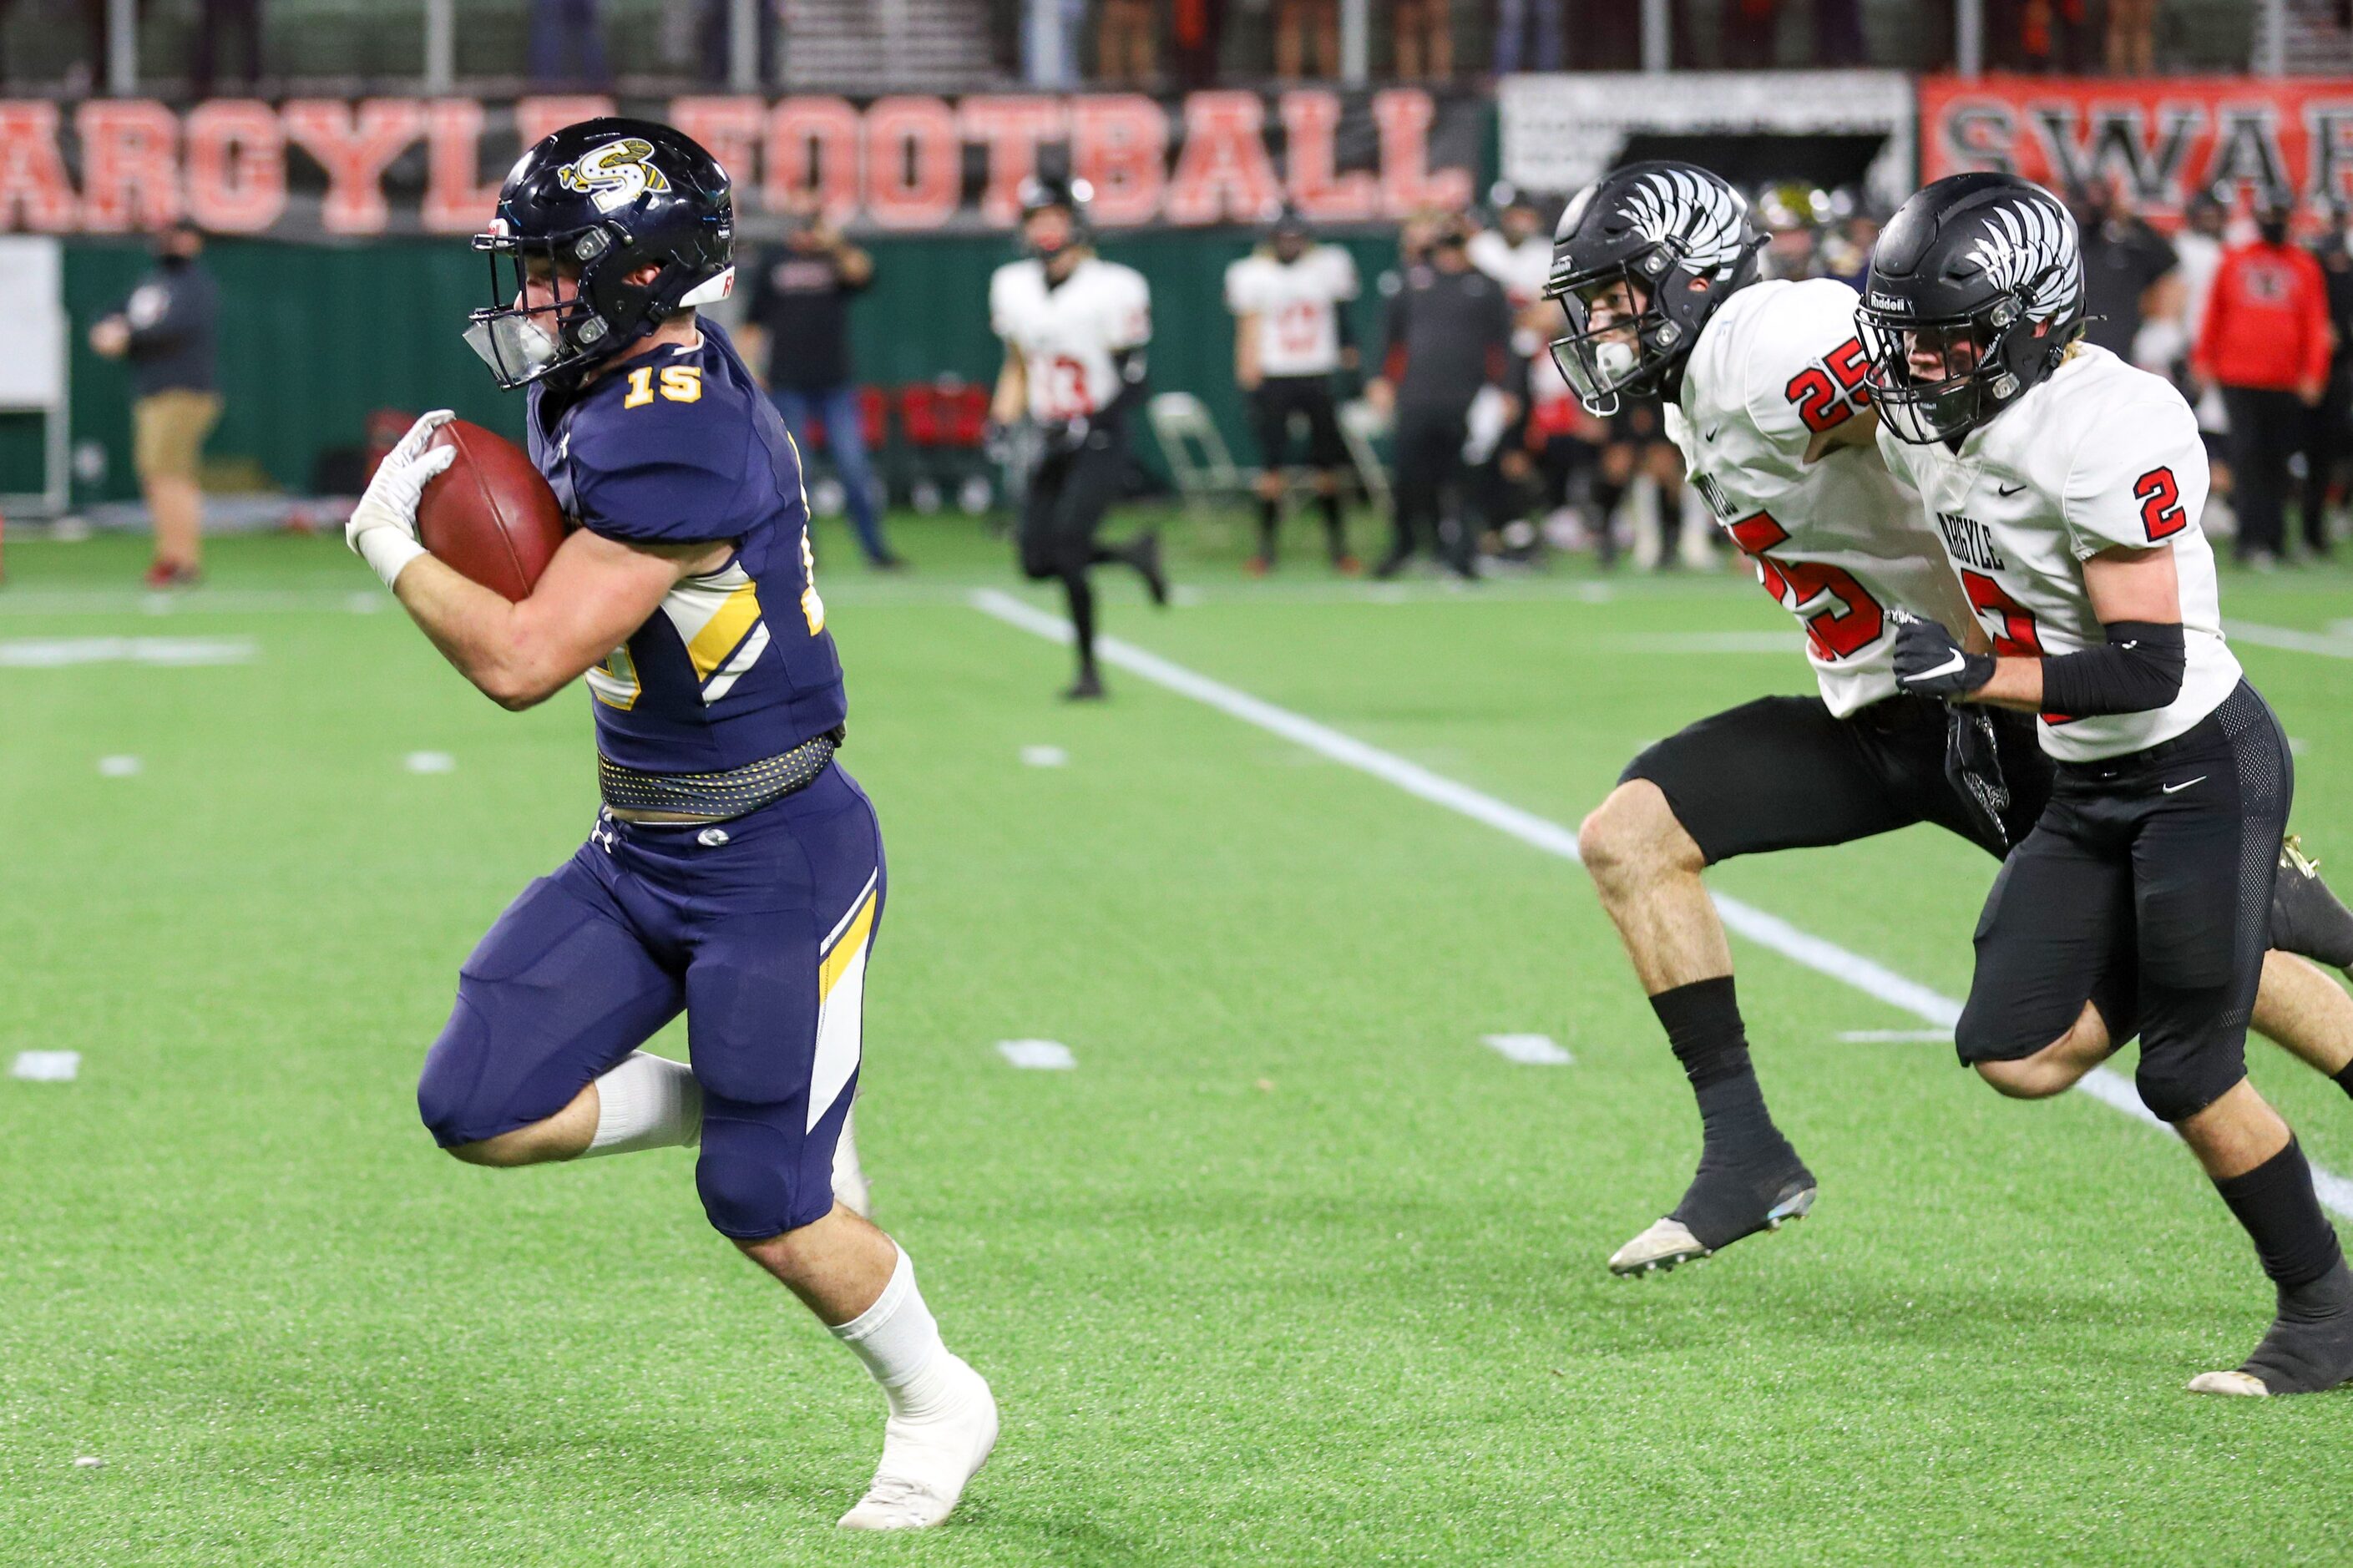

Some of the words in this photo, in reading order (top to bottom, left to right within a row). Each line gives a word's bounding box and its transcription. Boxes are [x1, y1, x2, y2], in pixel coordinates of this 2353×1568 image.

[0, 96, 617, 235] ARGYL
[1870, 294, 1905, 311] Riddell
[624, 366, 702, 409] 15
[1784, 336, 1886, 434] 25
[2133, 465, 2188, 543] 2
[1936, 512, 2006, 571] ARGYLE
